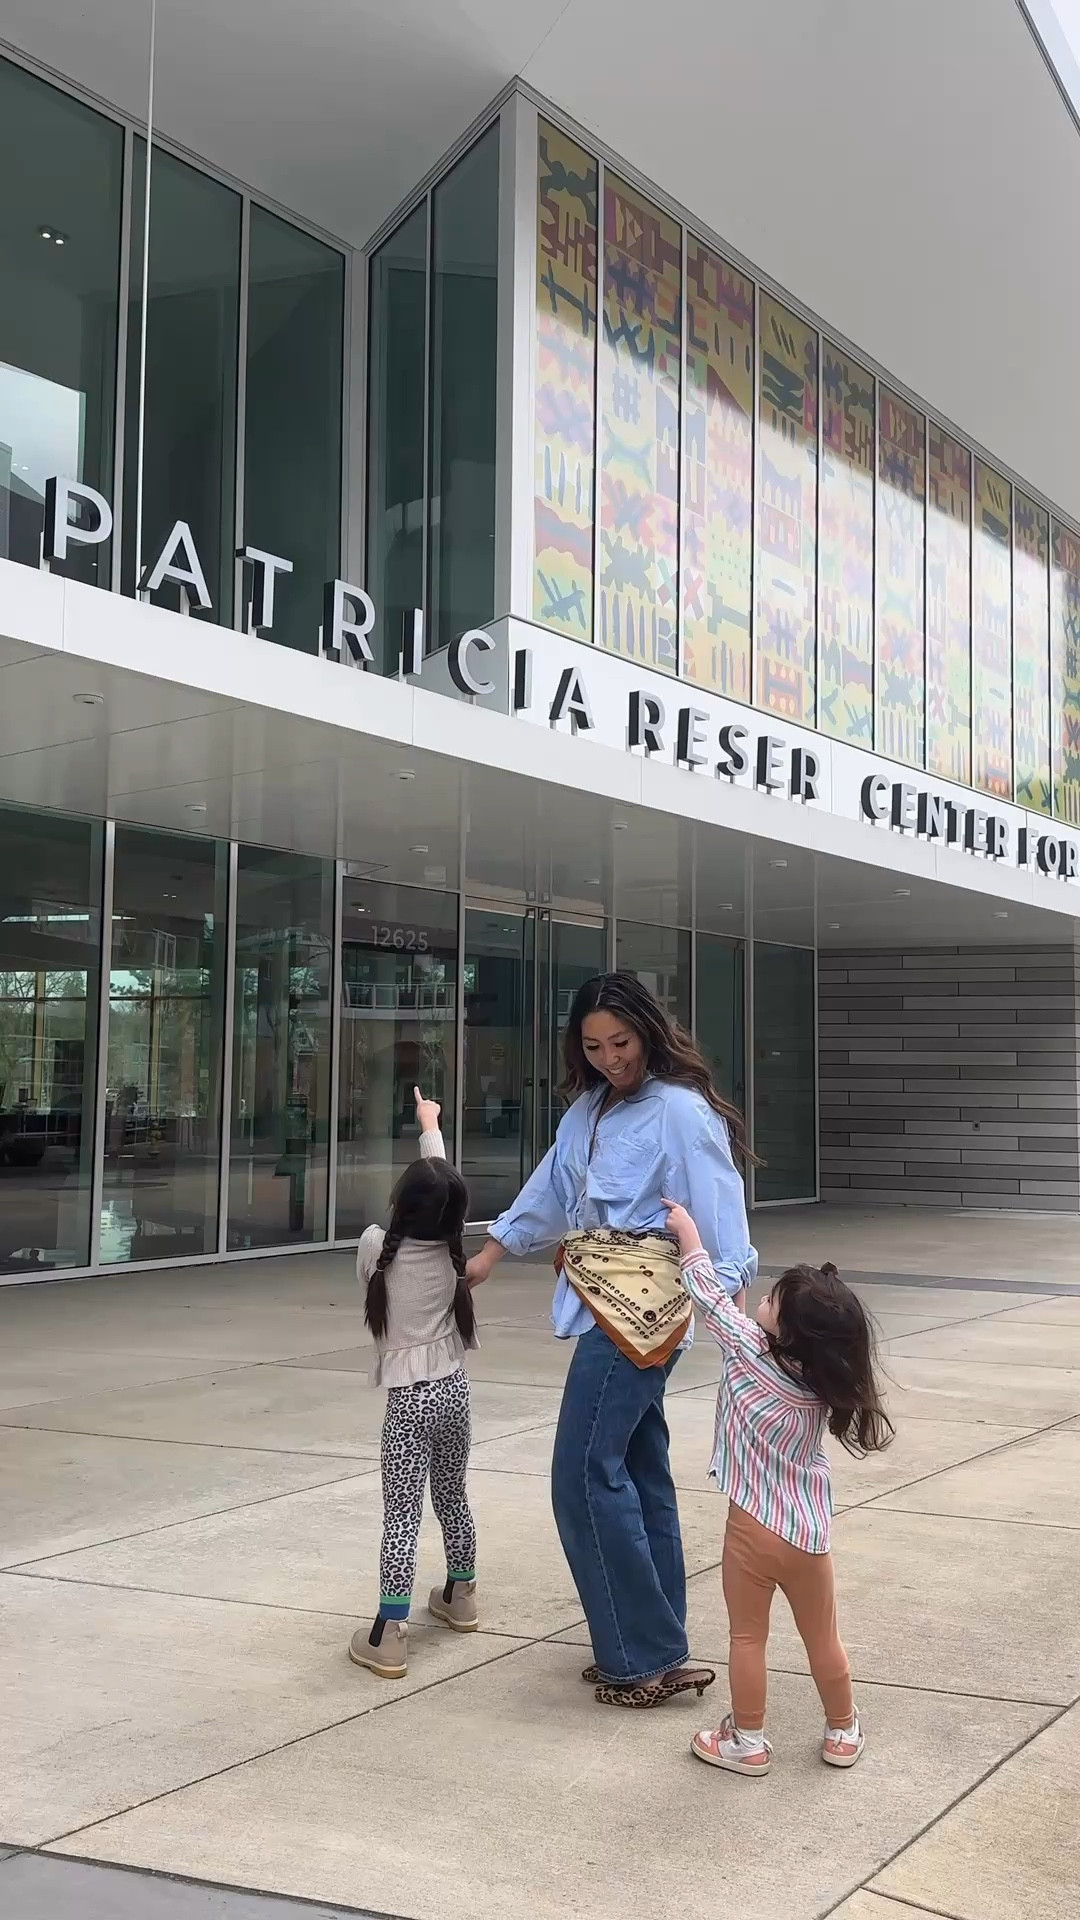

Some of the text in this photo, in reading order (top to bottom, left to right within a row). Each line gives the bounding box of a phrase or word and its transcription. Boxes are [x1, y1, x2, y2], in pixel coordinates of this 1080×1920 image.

[45, 475, 1080, 878] PATRICIA RESER CENTER FOR
[371, 925, 429, 952] 12625
